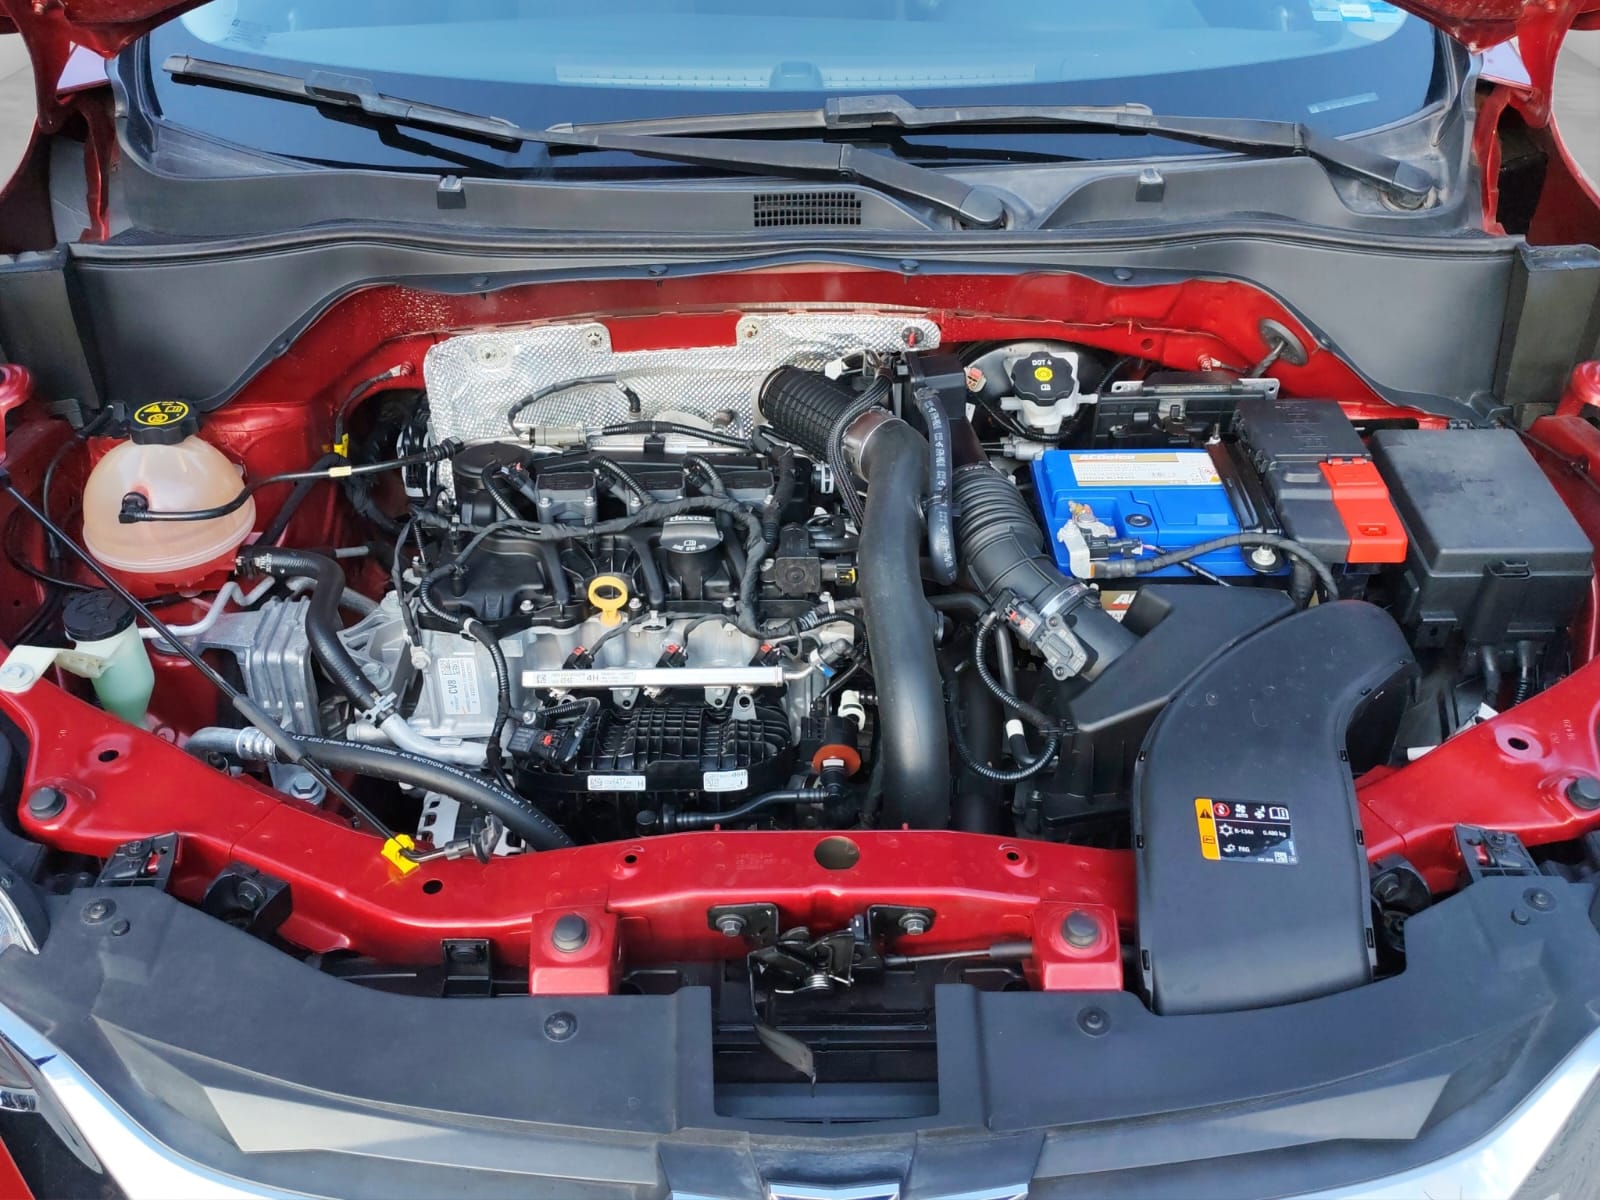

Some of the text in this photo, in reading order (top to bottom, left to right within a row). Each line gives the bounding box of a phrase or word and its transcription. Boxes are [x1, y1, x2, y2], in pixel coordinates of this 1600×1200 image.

[447, 679, 458, 694] CV8
[413, 755, 443, 769] SUCTION
[444, 765, 464, 776] HOSE
